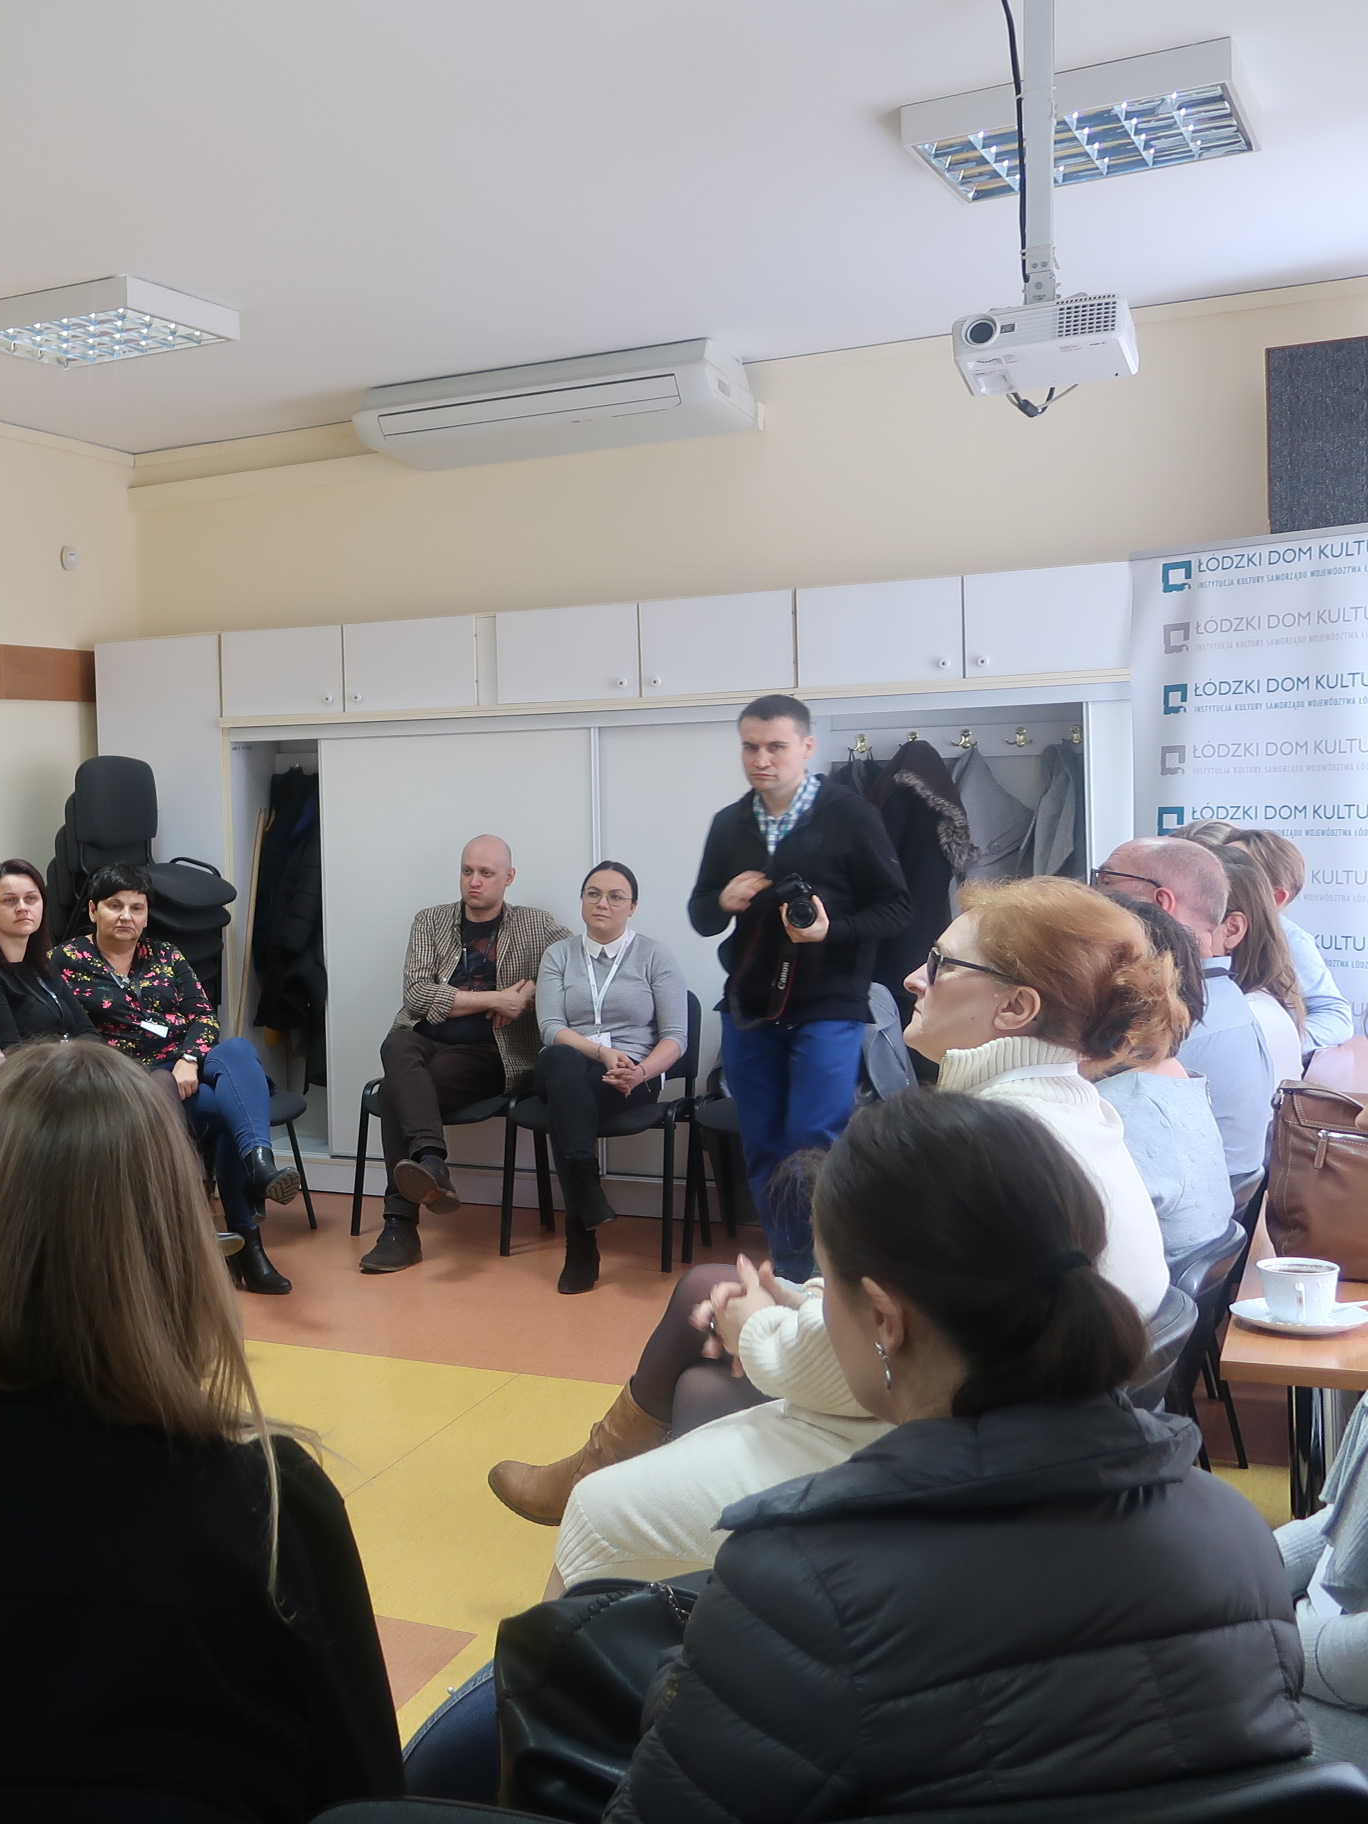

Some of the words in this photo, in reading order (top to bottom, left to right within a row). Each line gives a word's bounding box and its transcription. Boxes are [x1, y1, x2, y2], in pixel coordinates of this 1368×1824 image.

[1197, 552, 1262, 573] ŁÓDZKI
[1268, 546, 1312, 566] DOM
[1318, 540, 1368, 560] KULT
[1236, 576, 1265, 586] KULTURY
[1195, 615, 1261, 635] ŁÓDZKI
[1267, 611, 1311, 629] DOM
[1194, 678, 1260, 697] ŁÓDZKI
[1266, 675, 1310, 693] DOM
[1234, 702, 1263, 711] KULTURY
[1192, 740, 1259, 759] ŁÓDZKI
[1265, 740, 1308, 757] DOM
[1314, 738, 1368, 755] KULTU
[1191, 802, 1258, 820] ŁÓDZKI
[1264, 804, 1307, 820] DOM
[1313, 804, 1368, 820] KULTU
[1311, 869, 1368, 885] KULTU
[777, 961, 790, 990] Canon
